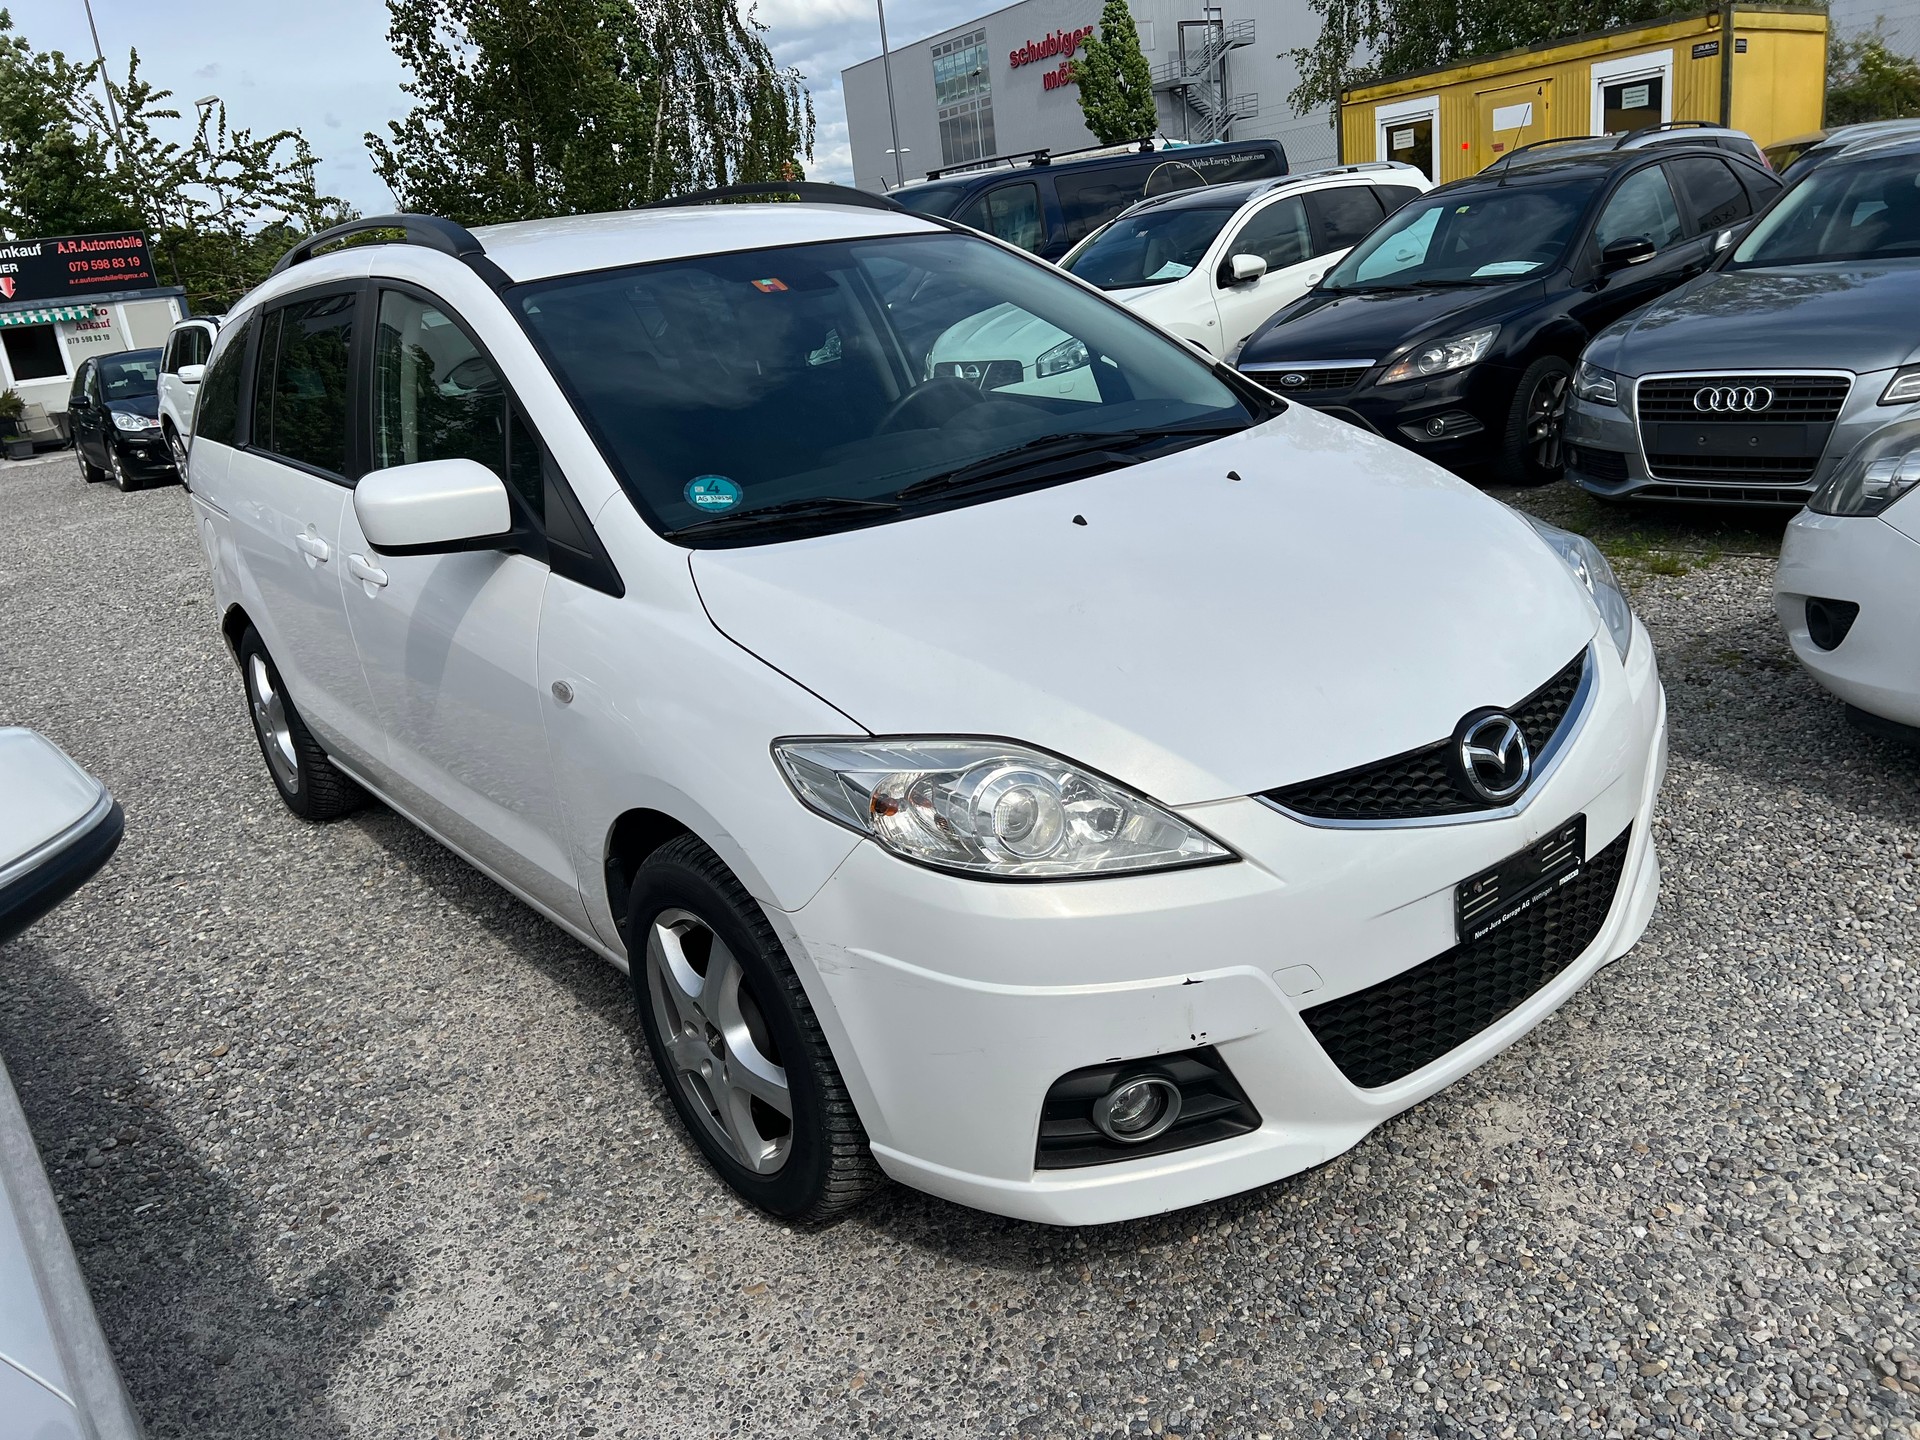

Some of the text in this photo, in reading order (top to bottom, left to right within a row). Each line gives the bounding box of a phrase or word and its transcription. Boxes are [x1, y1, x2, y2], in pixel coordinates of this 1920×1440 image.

[1009, 25, 1094, 69] schubiger
[1042, 61, 1078, 91] mö
[1537, 86, 1543, 97] 4
[1175, 154, 1265, 169] www.Alpha-Energy-Balance.com
[57, 236, 143, 254] A.R.Automobile
[68, 256, 140, 273] 079 598 83 19
[69, 271, 149, 285] a.r.automobile@gmx.ch
[94, 307, 108, 316] to
[76, 319, 111, 331] Ankauf
[706, 480, 720, 494] 4
[1475, 927, 1489, 940] Neue
[1489, 918, 1501, 930] Jura
[1502, 906, 1521, 922] Garage
[1521, 899, 1530, 910] AG
